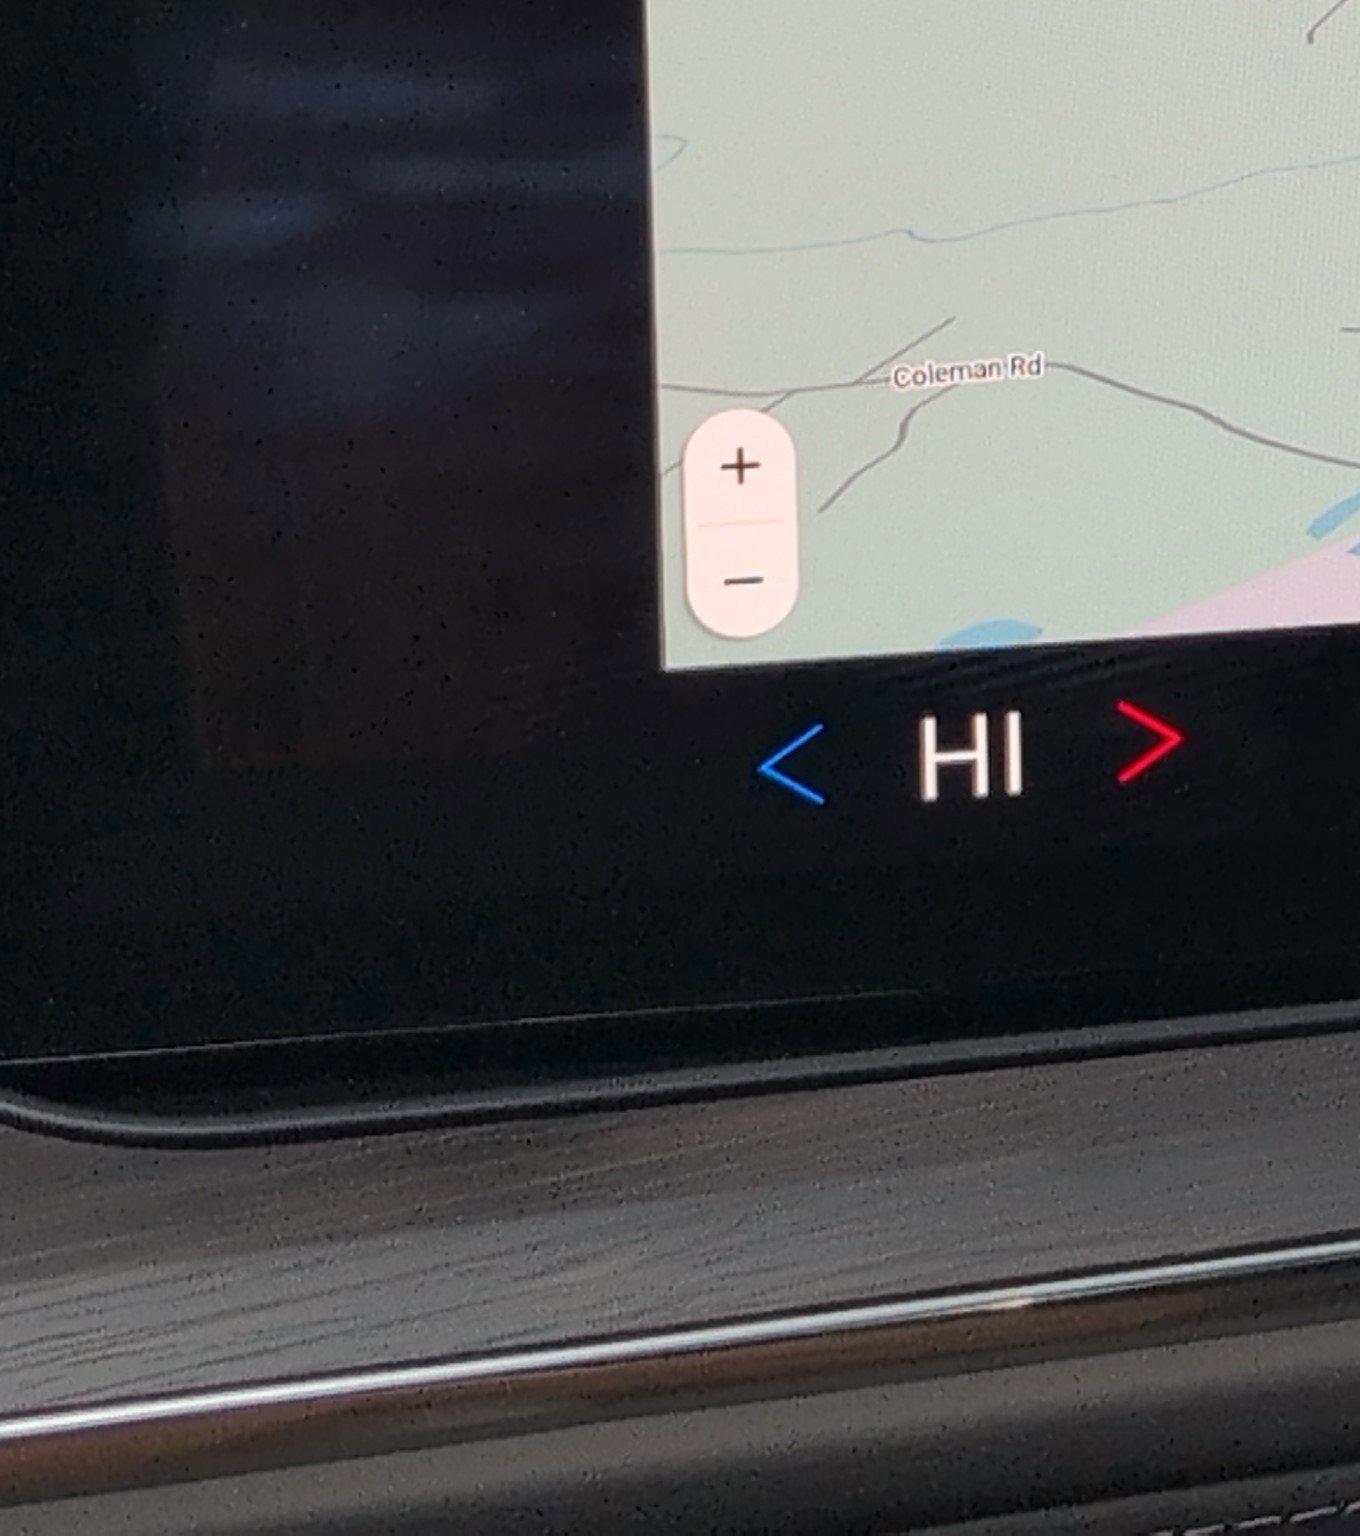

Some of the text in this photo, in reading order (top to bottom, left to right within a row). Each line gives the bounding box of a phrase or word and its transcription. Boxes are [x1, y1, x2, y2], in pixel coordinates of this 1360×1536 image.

[892, 354, 1043, 389] Coleman Rd
[920, 711, 1023, 802] HI
